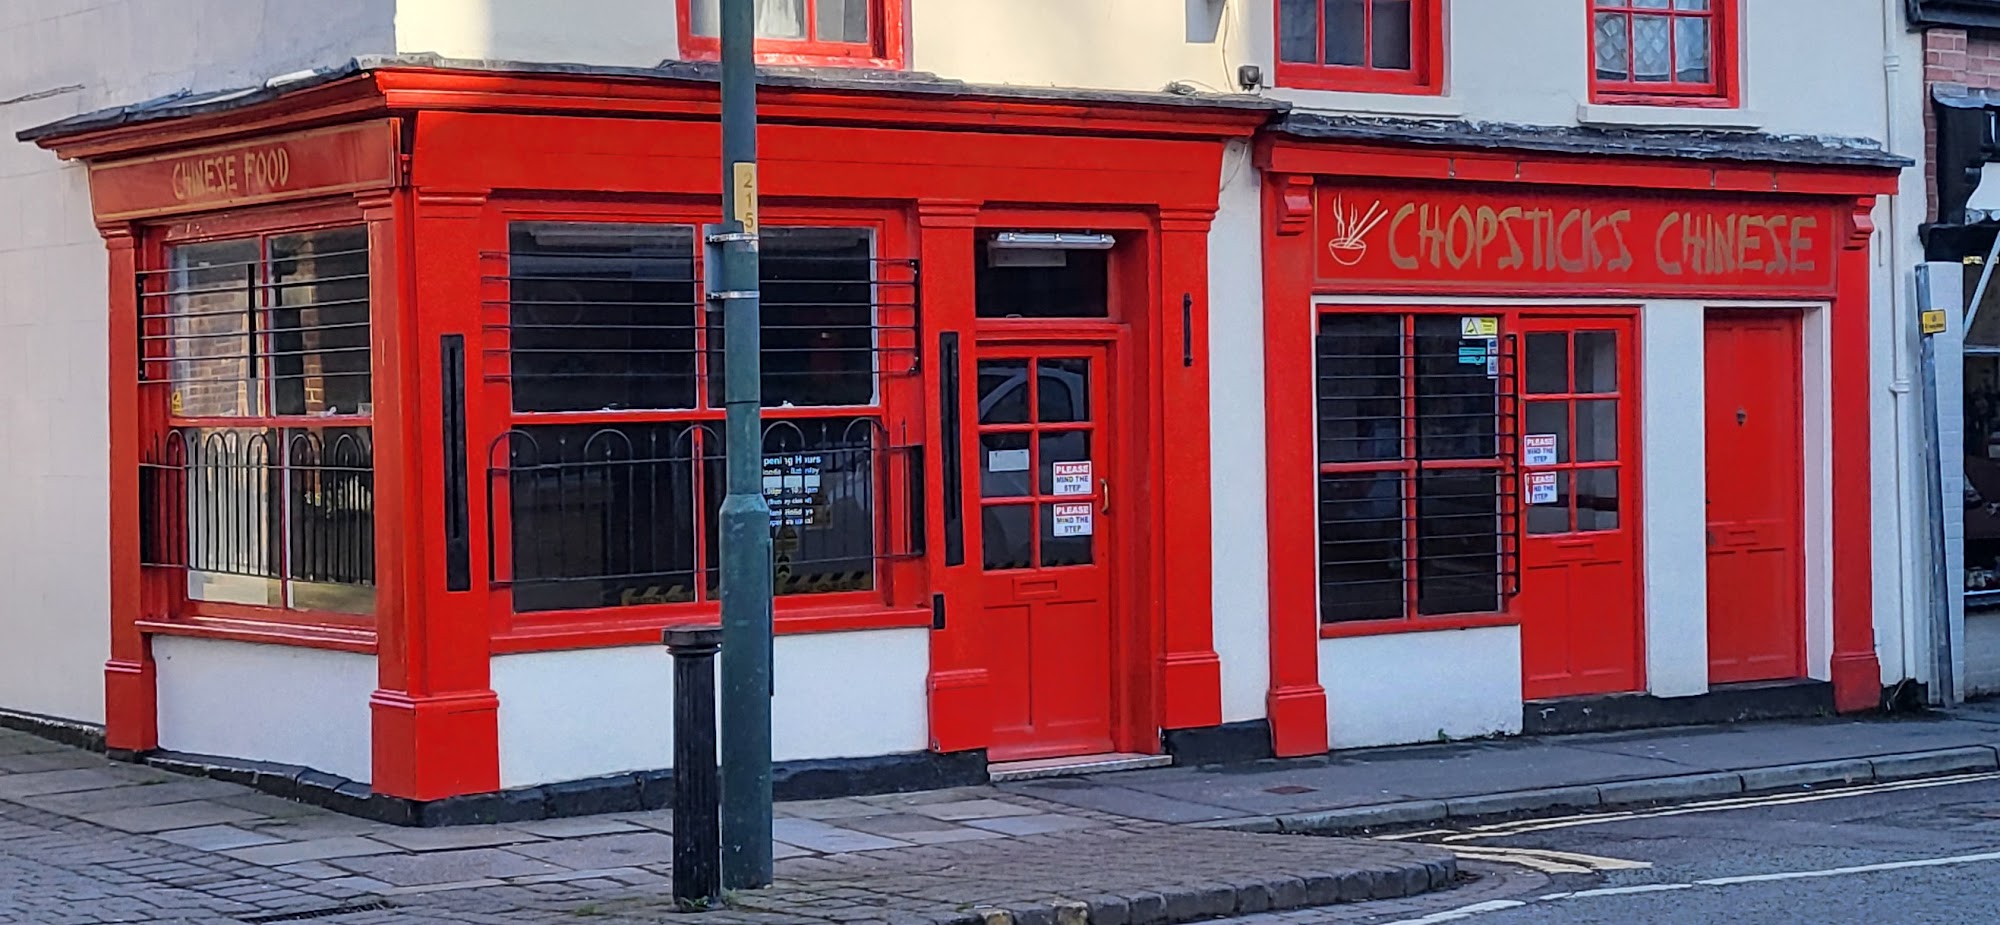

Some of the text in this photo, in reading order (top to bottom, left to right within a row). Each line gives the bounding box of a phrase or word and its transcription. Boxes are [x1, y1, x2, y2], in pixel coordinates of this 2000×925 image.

[172, 148, 289, 200] CHINESE FOOD
[743, 172, 754, 234] 215
[1388, 203, 1818, 275] CHOPSTICKS CHINESE
[1526, 437, 1554, 446] PLEASE
[763, 456, 794, 467] pening
[1533, 455, 1548, 463] STEP
[1056, 465, 1089, 475] PLEASE
[1075, 475, 1089, 483] THE
[1064, 484, 1082, 492] STEP
[1534, 492, 1549, 500] STEP
[1056, 506, 1089, 515] PLEASE
[1056, 516, 1074, 524] MIND
[1064, 525, 1082, 533] STEP
